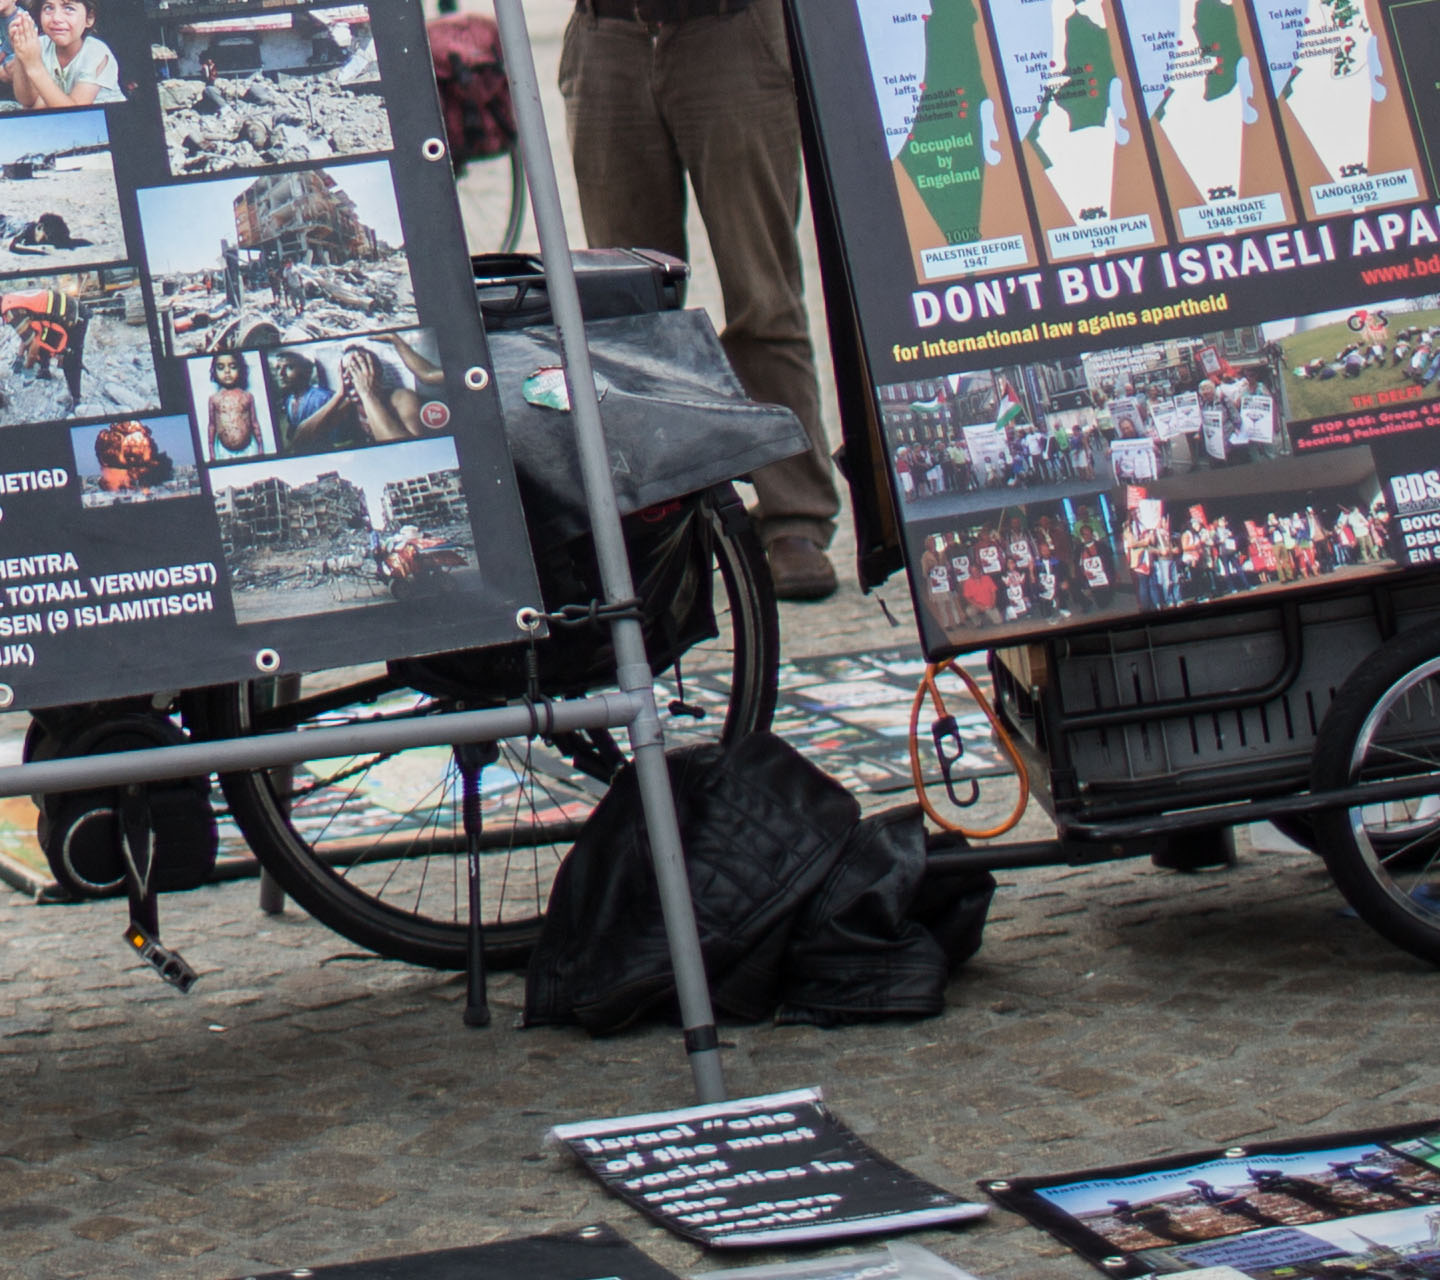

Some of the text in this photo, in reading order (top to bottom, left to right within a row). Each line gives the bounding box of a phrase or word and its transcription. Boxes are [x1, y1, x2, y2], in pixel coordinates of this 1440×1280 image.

[892, 13, 918, 24] Haifa
[1269, 7, 1302, 20] Tel Aviv
[1281, 20, 1303, 30] Jaffa
[1142, 30, 1175, 42] Tel Aviv
[1296, 35, 1341, 49] Jerusalem
[1152, 41, 1175, 51] Jaffa
[1014, 51, 1048, 63] Tel Aviv
[1165, 57, 1212, 71] Jerusalem
[1025, 63, 1048, 74] Jaffa
[1270, 61, 1293, 71] Gaza
[883, 73, 917, 85] Tel Aviv
[895, 86, 917, 96] Jaffa
[1142, 83, 1165, 93] Gaza
[1015, 105, 1038, 115] Gaza
[886, 127, 909, 136] Gaza
[909, 132, 973, 154] Occupied
[936, 155, 953, 169] by
[917, 167, 981, 189] Engeland
[1316, 175, 1407, 199] LANDGRAB FROM
[1351, 191, 1378, 205] 1992
[1199, 200, 1266, 219] UN MANDATE
[1206, 212, 1263, 229] 1948-1967
[945, 227, 982, 244] 100%
[1055, 220, 1147, 243] UN DIVISION PLAN
[1090, 236, 1116, 249] 1947
[925, 240, 1021, 263] PALESTINE BEFORE
[963, 256, 988, 269] 1947
[1058, 255, 1144, 304] BUY
[1160, 225, 1335, 288] ISRAELI
[892, 344, 919, 363] for
[1042, 319, 1073, 339] law
[1078, 310, 1138, 335] agains
[1141, 293, 1228, 327] apartheid
[1298, 430, 1352, 449] Securing
[1353, 419, 1423, 439] Palestinian
[1312, 420, 1344, 435] STOP
[1408, 549, 1431, 564] EN
[7, 579, 87, 606] TOTAAL
[90, 562, 217, 595] VERWOEST)
[47, 610, 69, 633] (9
[75, 591, 213, 627] ISLAMITISCH
[584, 1124, 696, 1153] Israel
[606, 1126, 816, 1172] of the most
[625, 1160, 729, 1191] racist
[644, 1160, 855, 1202] societies in
[1046, 1183, 1090, 1196] Hand
[1115, 1175, 1158, 1186] Hand
[659, 1194, 728, 1215] the
[677, 1193, 843, 1223] Western
